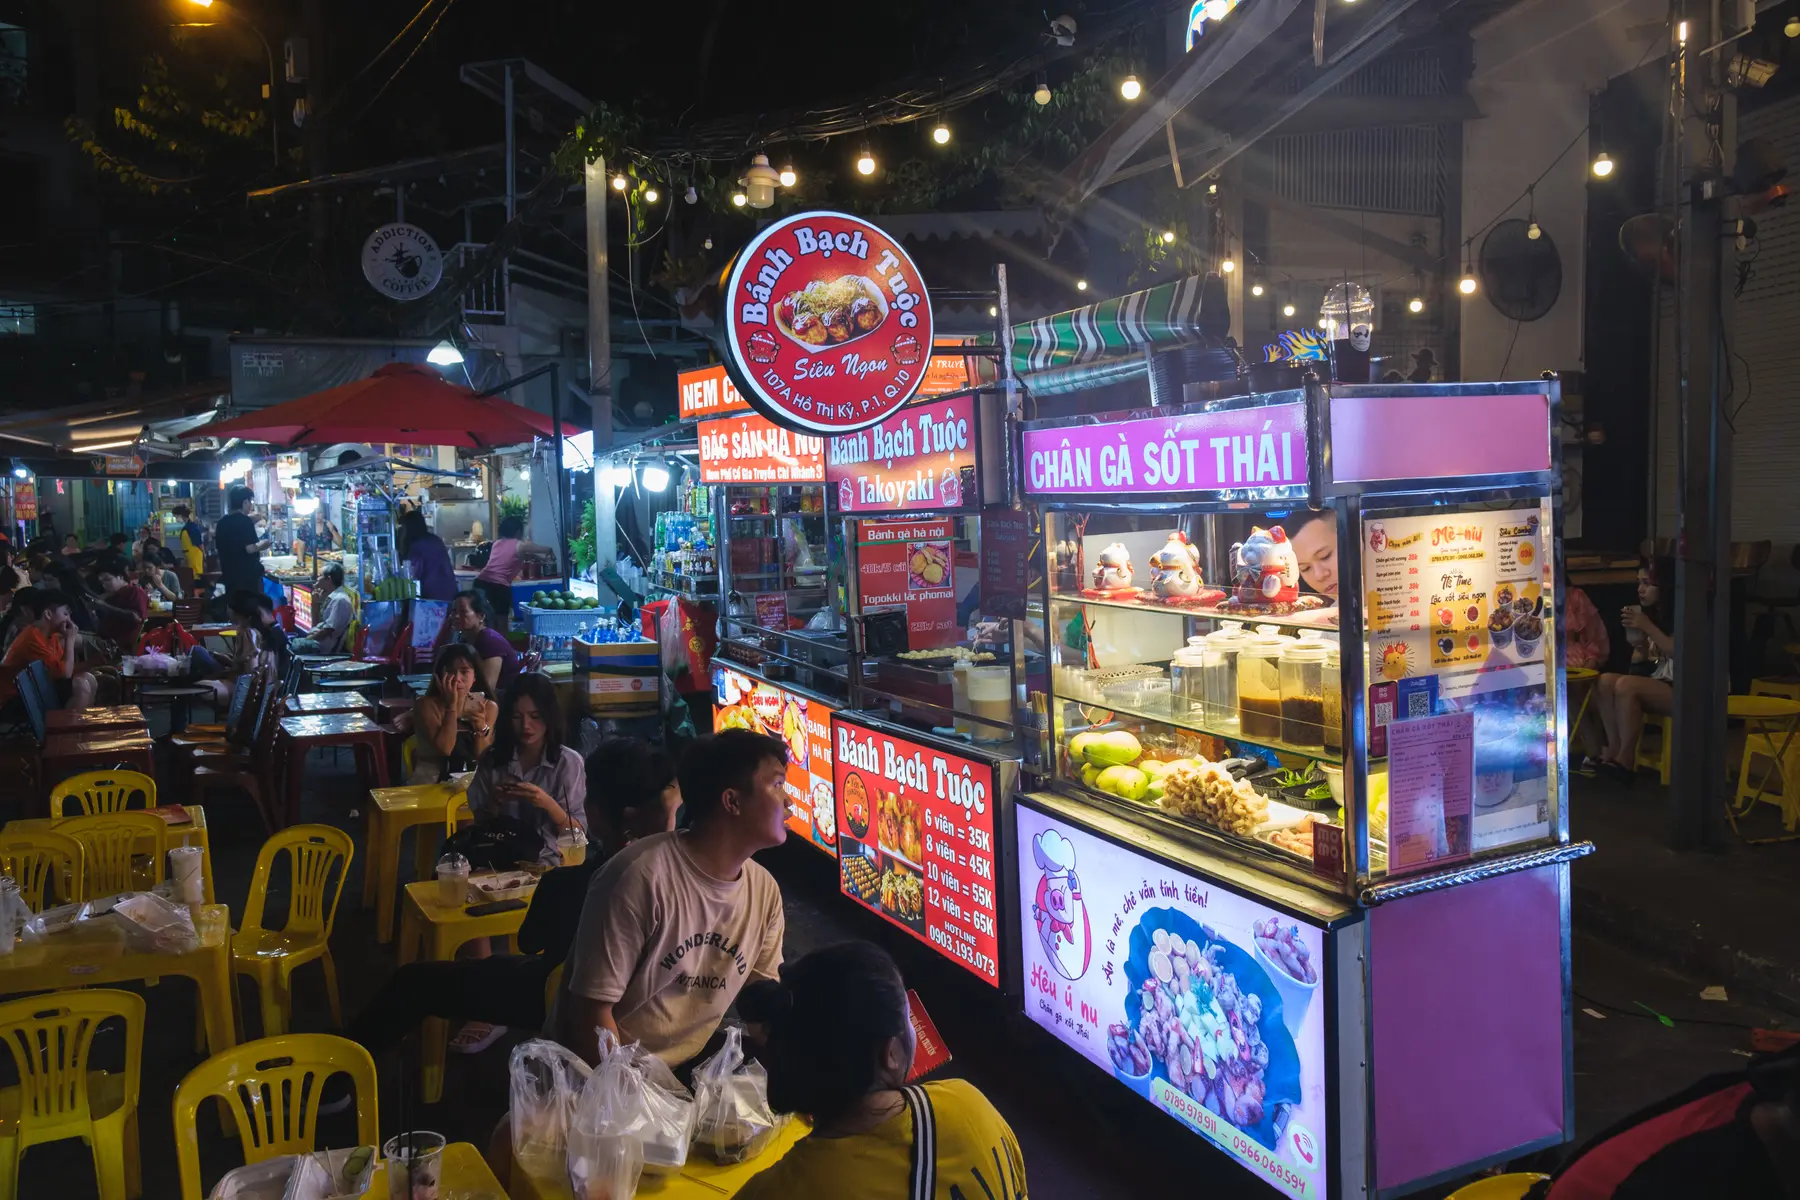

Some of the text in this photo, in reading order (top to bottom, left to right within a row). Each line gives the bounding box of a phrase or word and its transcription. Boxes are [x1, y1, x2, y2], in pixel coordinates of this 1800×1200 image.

[371, 227, 434, 254] ADDICTION
[741, 226, 920, 328] Bánh Bạch Tuộc
[793, 353, 888, 381] Siêu Ngon
[683, 378, 718, 411] NEM
[762, 368, 791, 401] 107A
[793, 393, 812, 412] Hồ
[816, 402, 834, 420] Thị
[862, 395, 886, 413] P.1,
[884, 369, 910, 398] Q.10
[701, 429, 728, 466] ĐẶC
[732, 422, 763, 459] SẢN
[872, 419, 915, 469] Bạch
[919, 408, 967, 463] Tuộc
[1030, 419, 1292, 489] CHÂN GÀ SỐT THÁI
[816, 464, 823, 479] 3
[858, 468, 934, 507] Takoyaki
[868, 529, 894, 540] Bánh
[929, 527, 944, 538] nội
[863, 593, 901, 605] Topokki
[920, 589, 953, 602] phomai
[837, 726, 880, 775] Bánh
[883, 740, 929, 795] Bạch
[933, 756, 985, 822] Tuộc
[925, 808, 932, 827] 6
[934, 813, 955, 837] viên
[968, 825, 991, 852] 35K
[926, 833, 933, 852] 8
[935, 839, 956, 864] viên
[969, 853, 992, 880] 45K
[927, 861, 938, 882] 10
[940, 869, 960, 893] viên
[972, 882, 993, 911] 55K
[1123, 891, 1137, 914] chê
[1139, 880, 1156, 900] vẫn
[1160, 879, 1179, 900] tính
[1185, 883, 1208, 908] tiền!
[927, 886, 940, 908] 12
[942, 895, 961, 919] viên
[973, 910, 995, 938] 65K
[944, 921, 977, 947] HOTLINE
[660, 932, 747, 976] WONDERLAND
[929, 924, 996, 977] 0903.193.073
[1164, 1089, 1216, 1134] 0789.978.911
[1233, 1135, 1306, 1194] 0966.068.594
